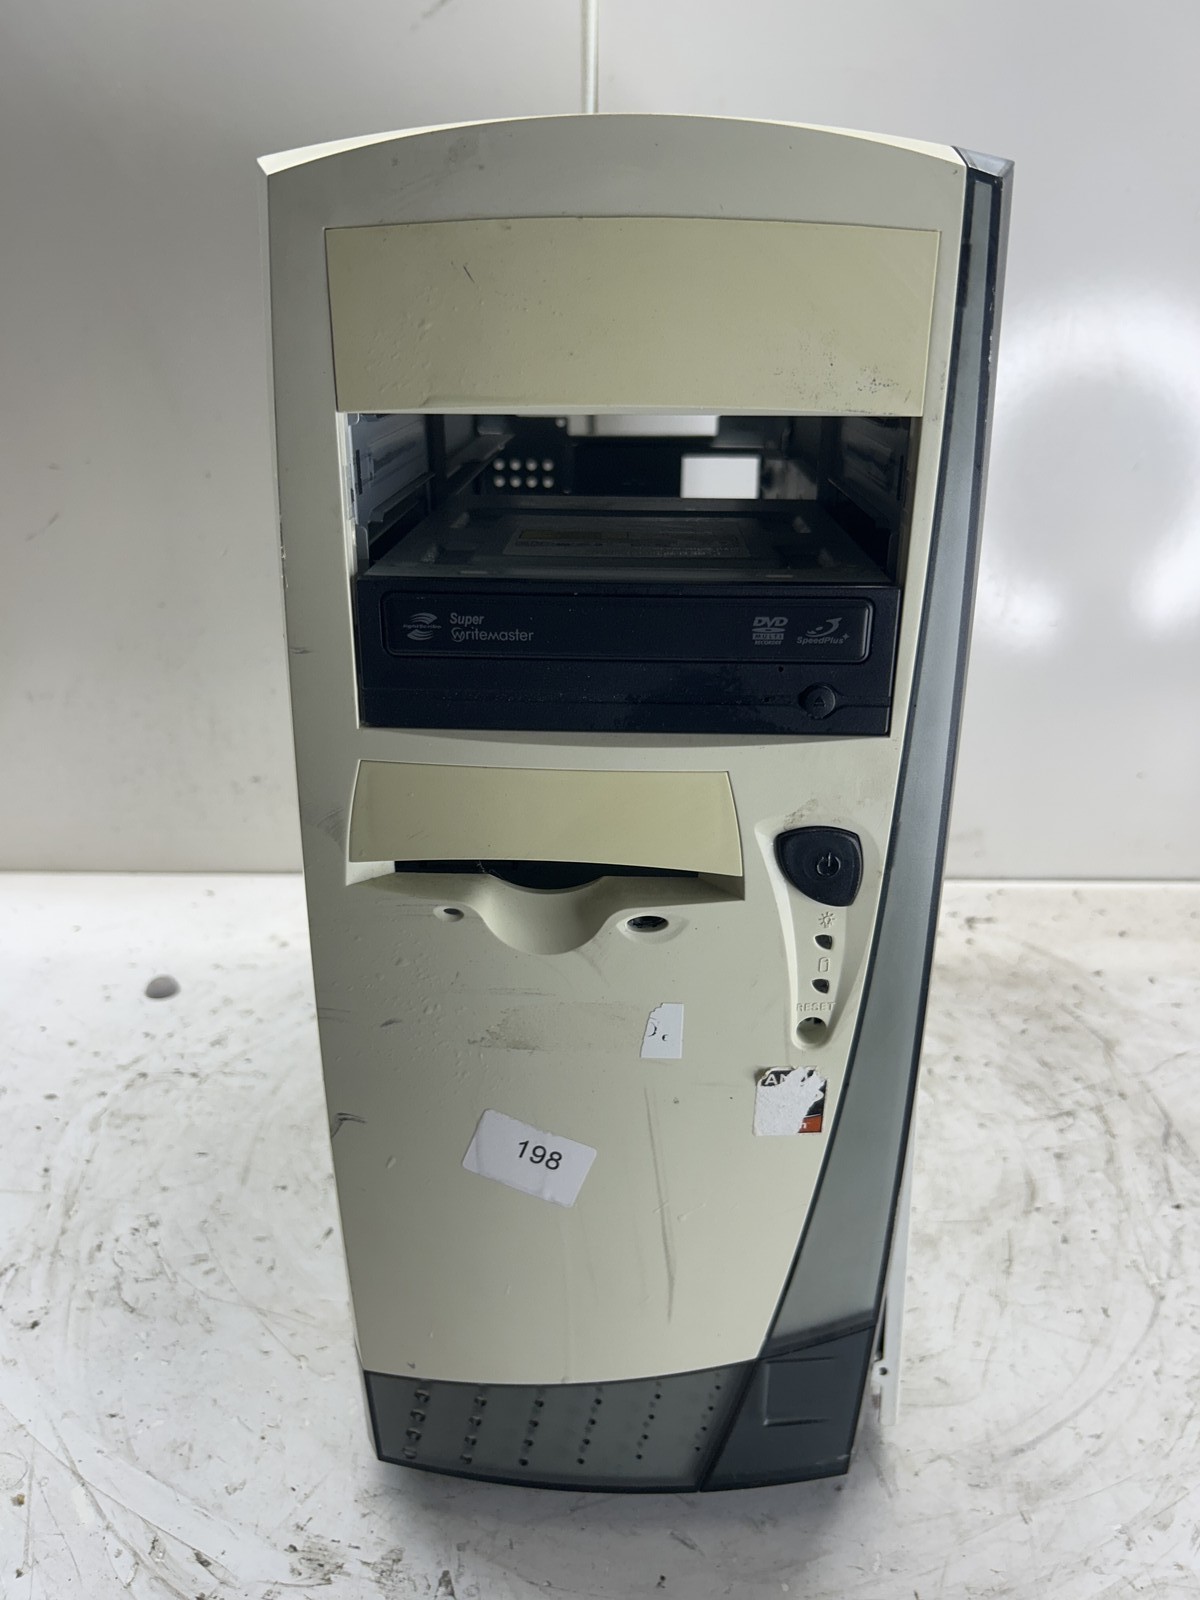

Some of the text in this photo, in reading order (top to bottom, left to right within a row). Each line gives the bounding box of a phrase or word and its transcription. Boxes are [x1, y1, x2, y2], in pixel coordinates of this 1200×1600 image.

[449, 612, 484, 627] Super
[752, 616, 789, 628] DVD
[796, 636, 844, 646] SpeedPlus
[797, 1002, 836, 1012] RESET
[518, 1140, 563, 1171] 198
